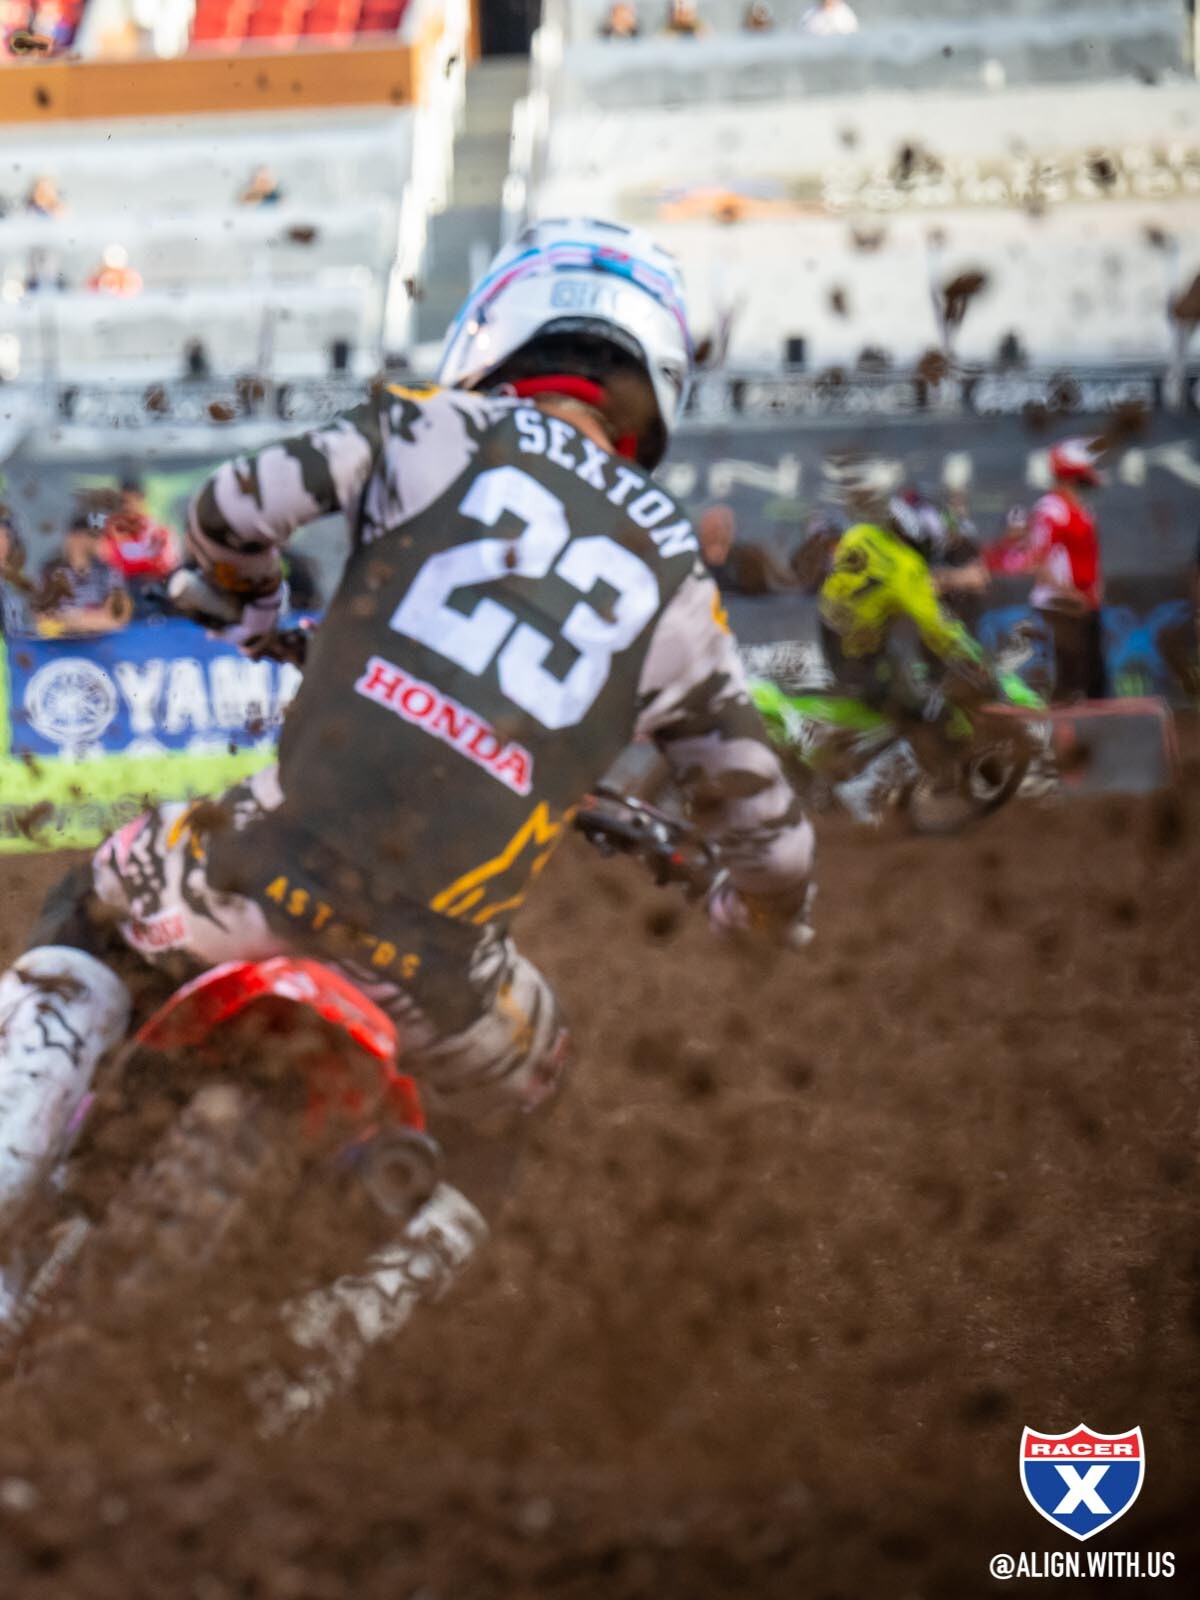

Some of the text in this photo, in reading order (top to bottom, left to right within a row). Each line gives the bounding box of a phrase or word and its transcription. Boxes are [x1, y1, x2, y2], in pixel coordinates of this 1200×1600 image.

[514, 408, 698, 559] SEXTON
[389, 465, 661, 731] 23
[360, 664, 531, 788] HONDA
